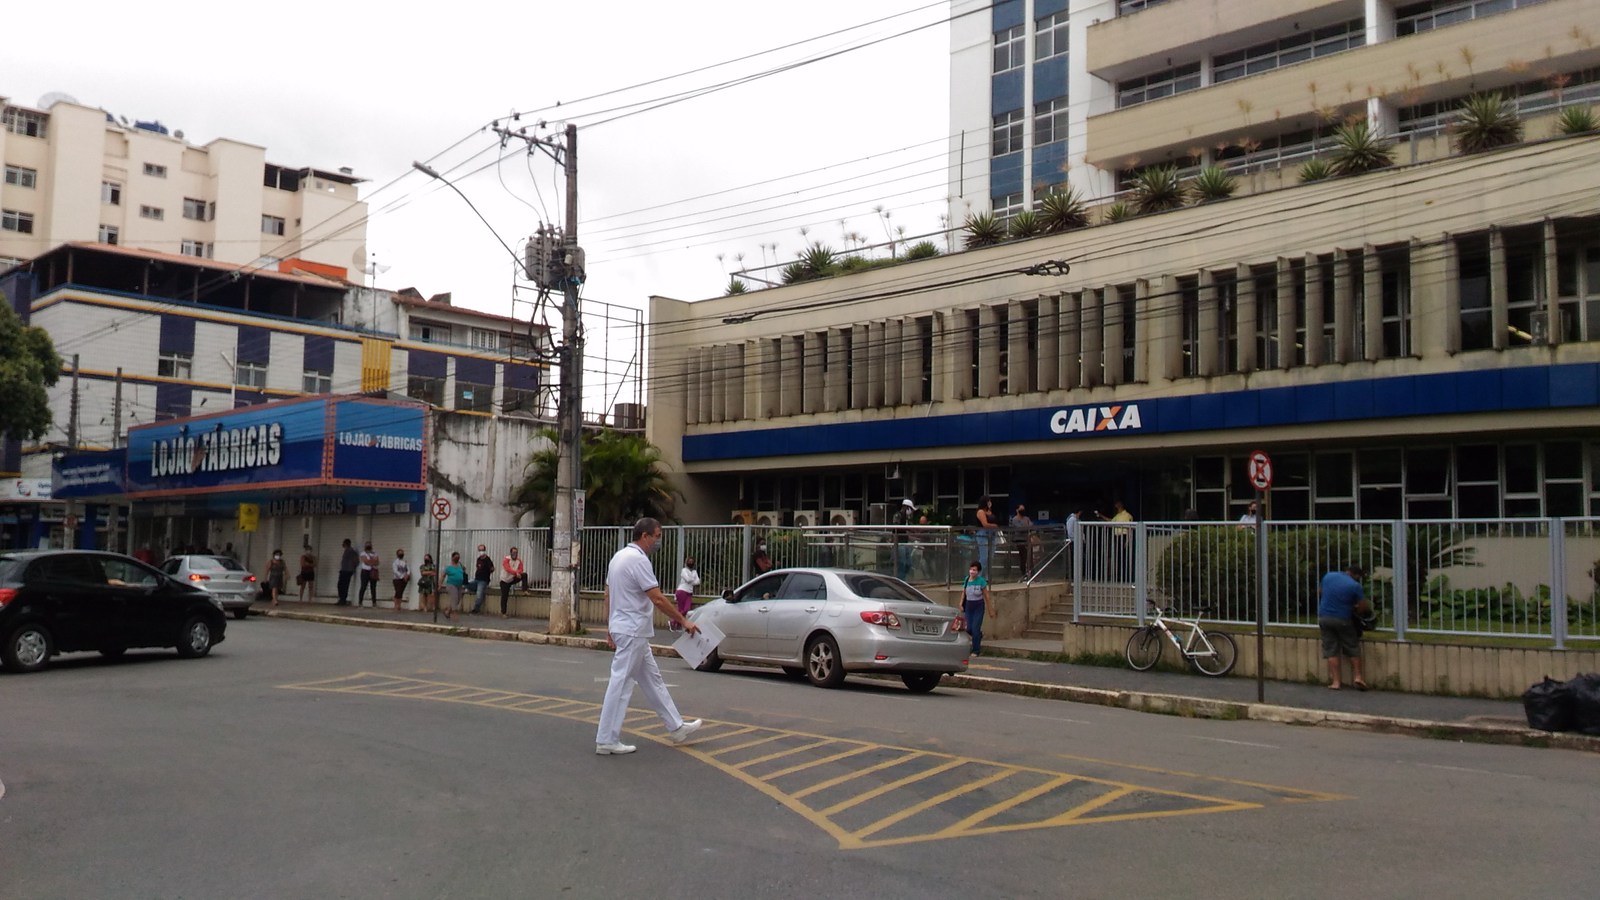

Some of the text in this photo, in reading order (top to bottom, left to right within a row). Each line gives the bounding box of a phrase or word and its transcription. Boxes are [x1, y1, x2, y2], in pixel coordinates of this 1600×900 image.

[1050, 404, 1142, 434] CAIXA
[151, 422, 281, 477] LOJÃO FÁBRICAS
